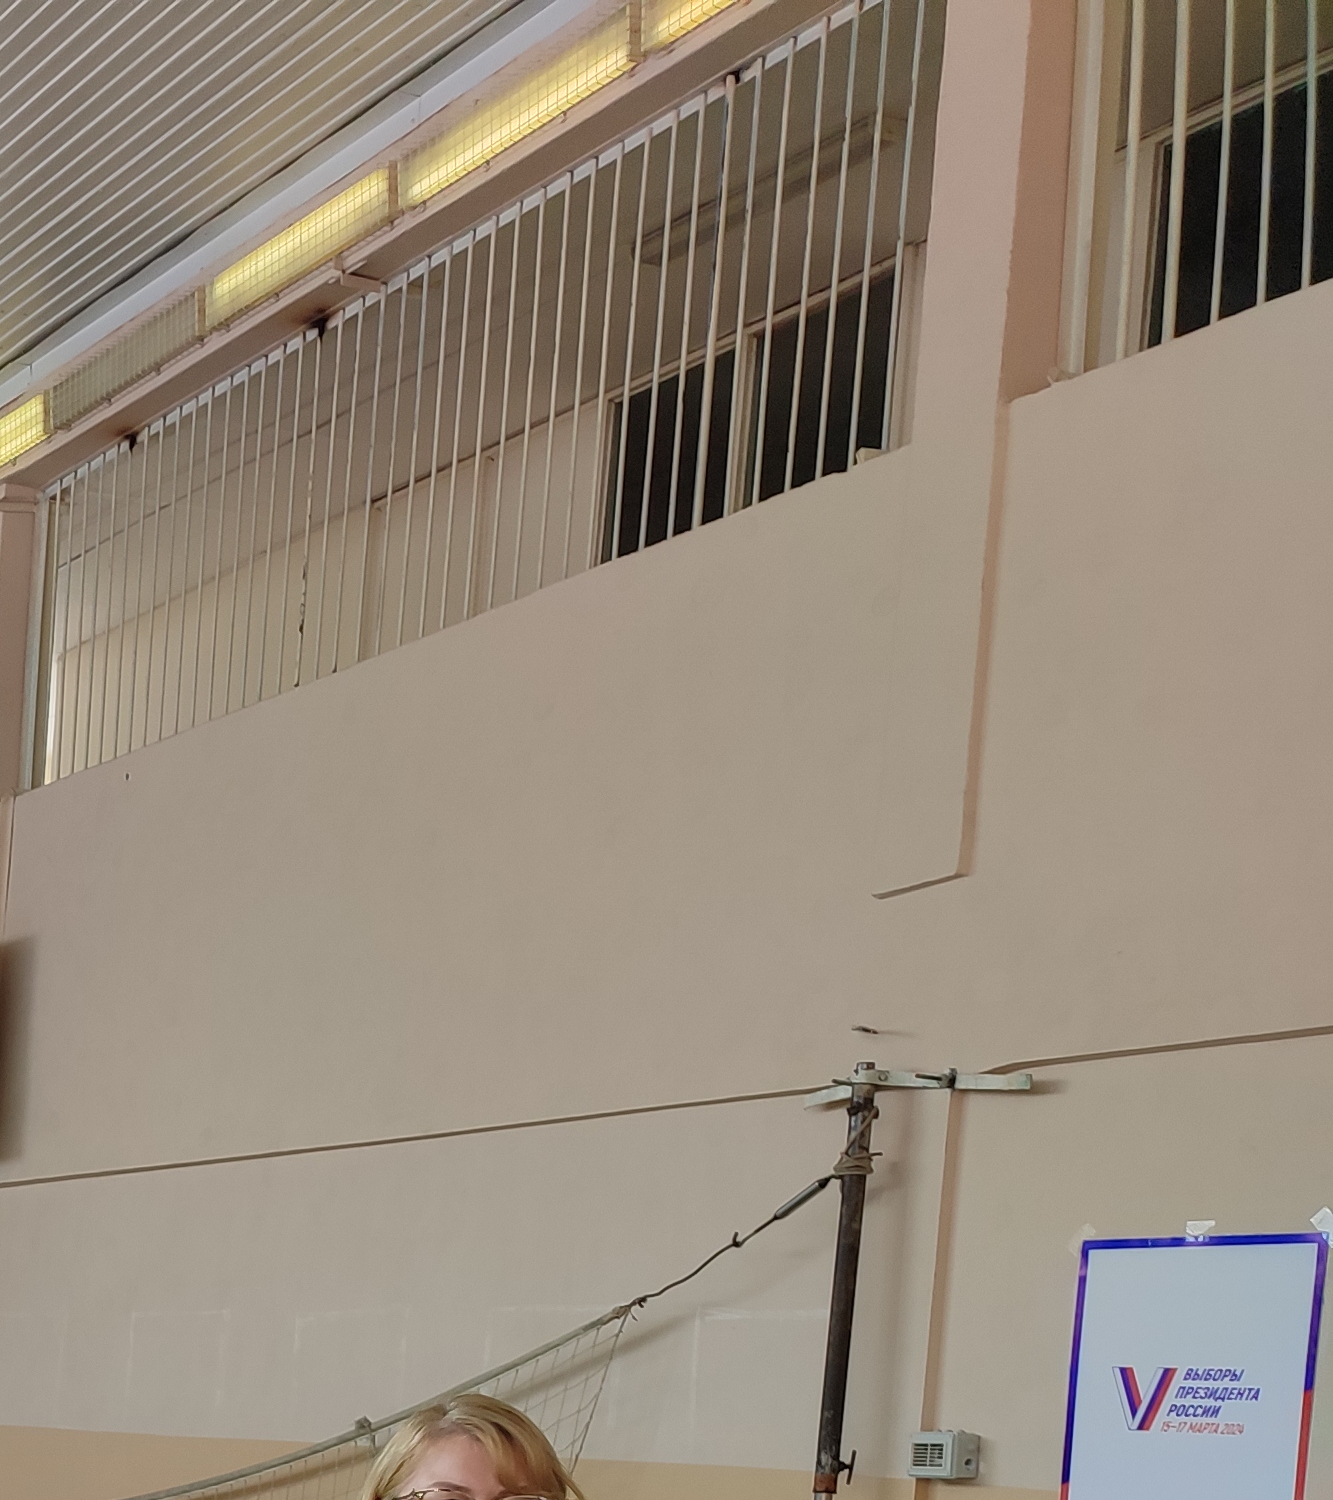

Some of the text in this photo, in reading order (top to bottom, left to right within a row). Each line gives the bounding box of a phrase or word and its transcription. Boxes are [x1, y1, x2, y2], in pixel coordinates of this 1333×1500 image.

[1183, 1368, 1244, 1382] ВЫБОРЫ
[1174, 1386, 1261, 1402] ПРЕЗИДЕНТА
[1166, 1404, 1222, 1418] РОССИИ
[1188, 1422, 1219, 1434] МАРТА
[1220, 1423, 1245, 1435] 2024
